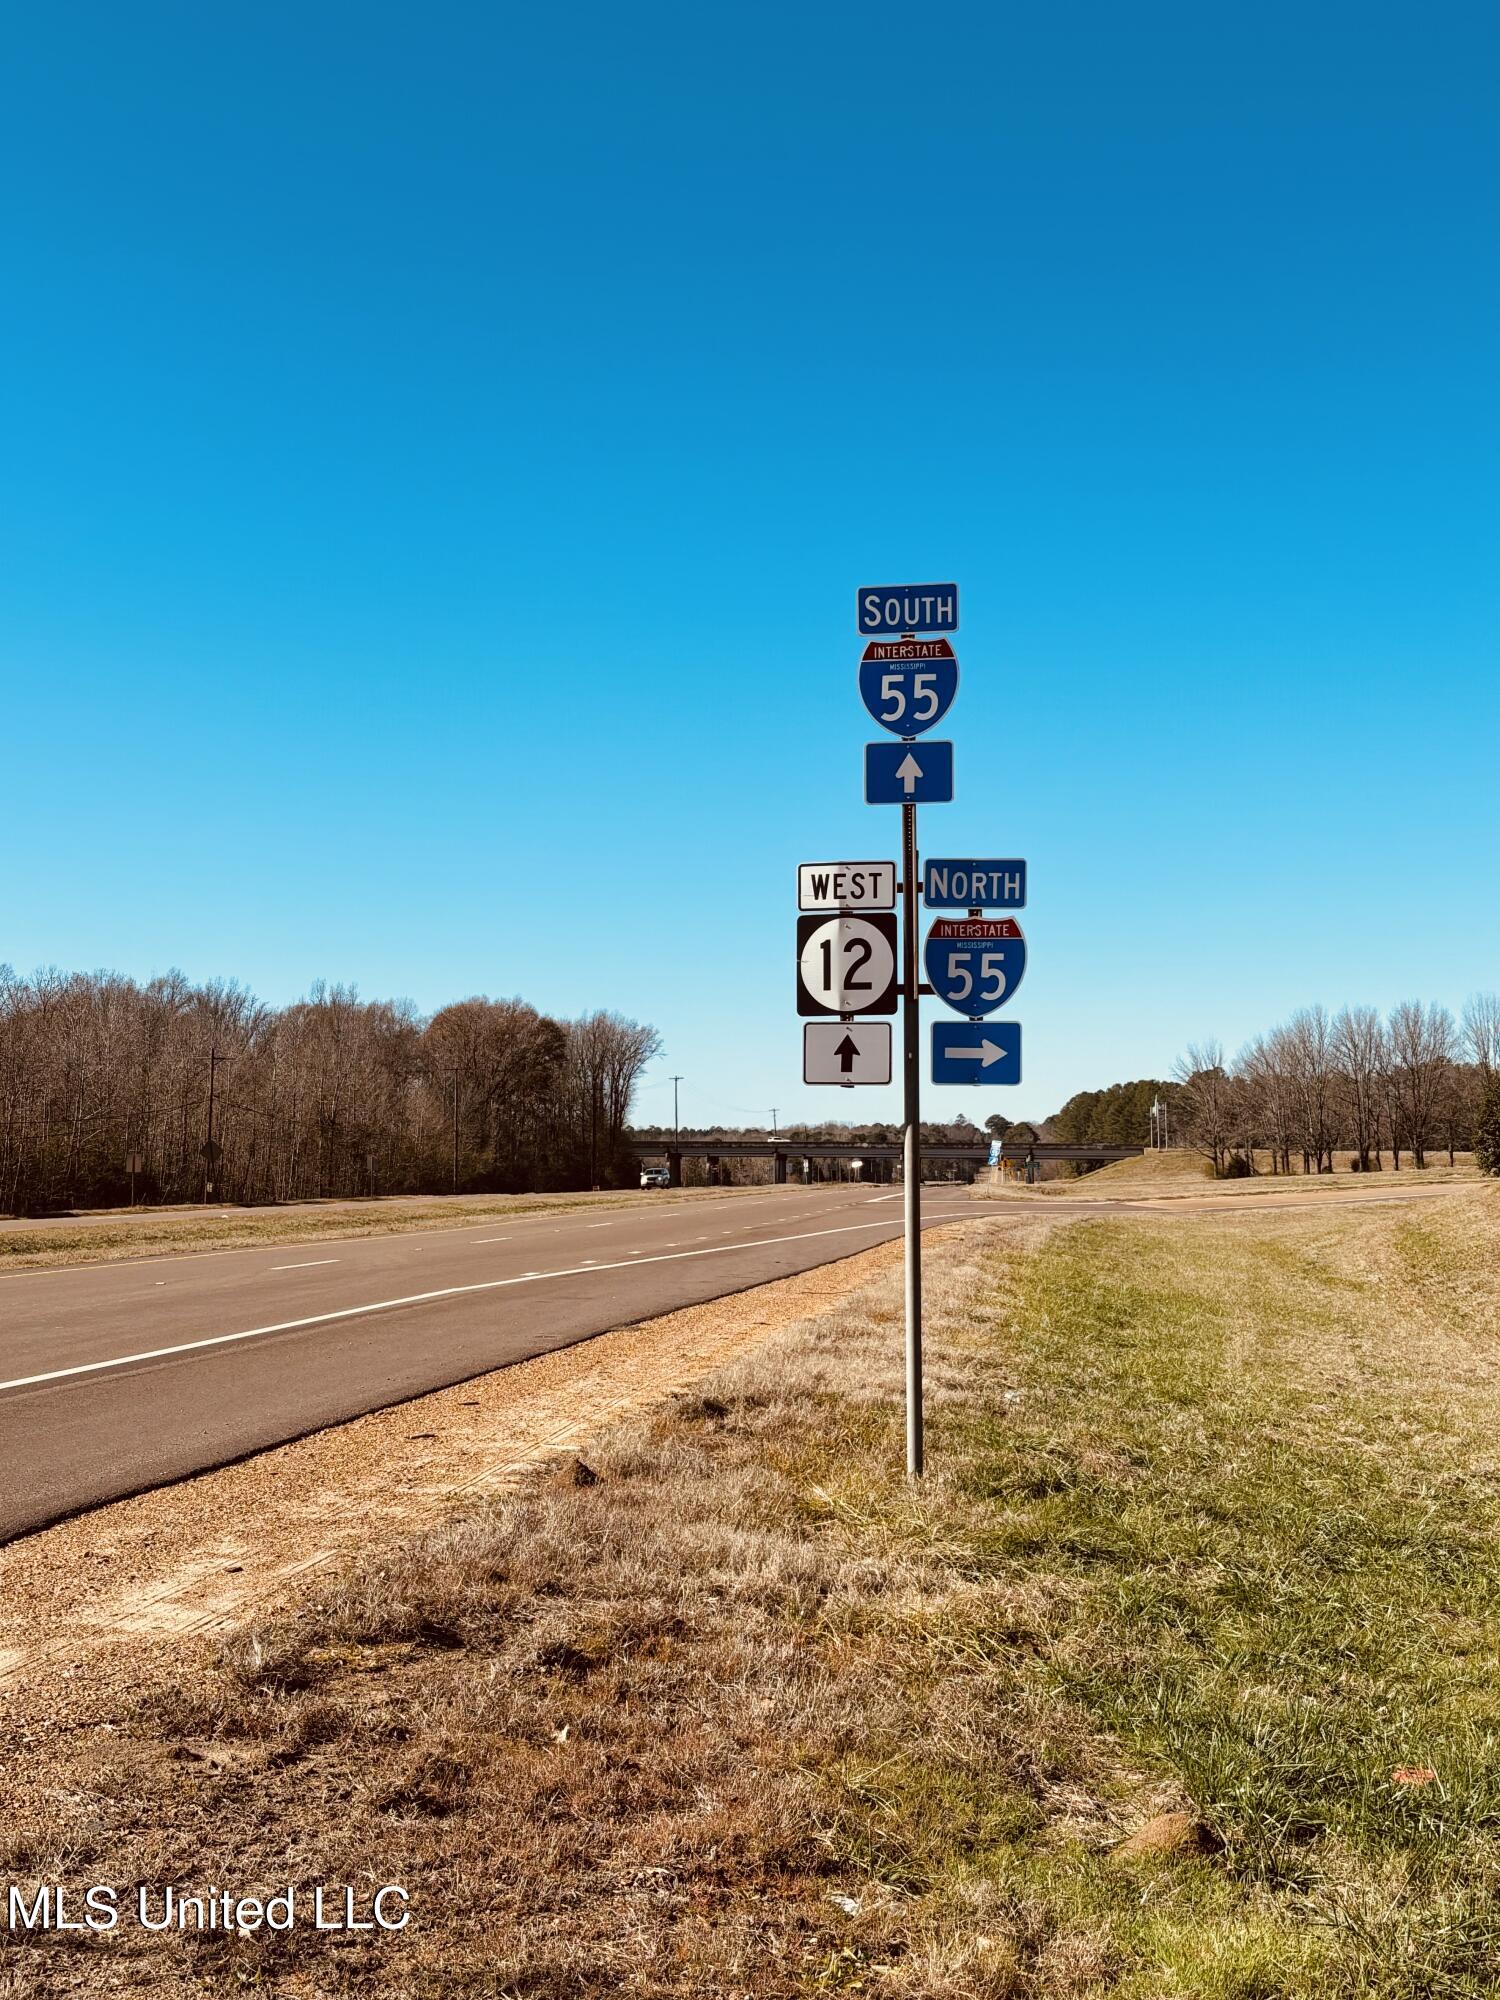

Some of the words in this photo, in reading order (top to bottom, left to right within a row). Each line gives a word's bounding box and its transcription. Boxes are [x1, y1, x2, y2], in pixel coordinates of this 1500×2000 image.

[864, 595, 953, 627] SOUTH
[874, 644, 942, 659] INTERSTATE
[889, 662, 926, 671] MISSISSIPPI
[880, 673, 939, 722] 55
[811, 872, 882, 901] WEST
[930, 867, 1020, 900] NORTH
[940, 924, 1010, 937] INTERSTATE
[956, 941, 994, 949] MISSISSIPPI
[819, 937, 873, 991] 12
[946, 952, 1007, 1001] 55
